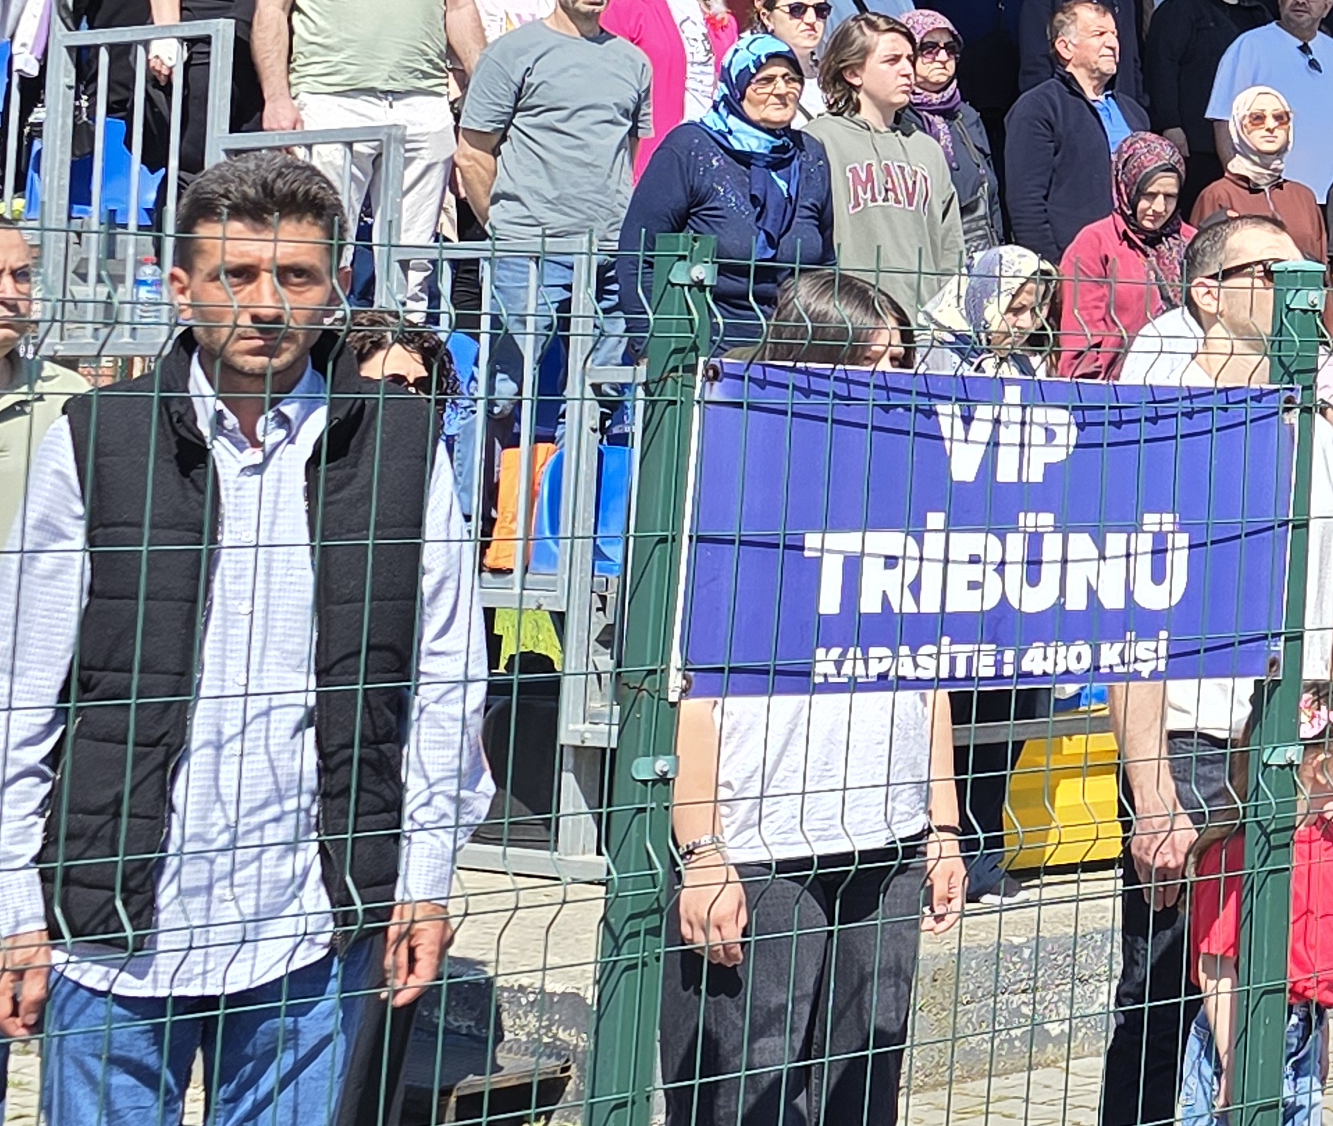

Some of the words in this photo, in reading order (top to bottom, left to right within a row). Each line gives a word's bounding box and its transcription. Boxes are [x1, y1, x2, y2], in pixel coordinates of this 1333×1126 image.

[934, 385, 1078, 483] VİP
[803, 512, 1190, 615] TRİBÜNÜ
[814, 636, 997, 683] KAPASİTE
[1100, 630, 1168, 678] KİŞİ
